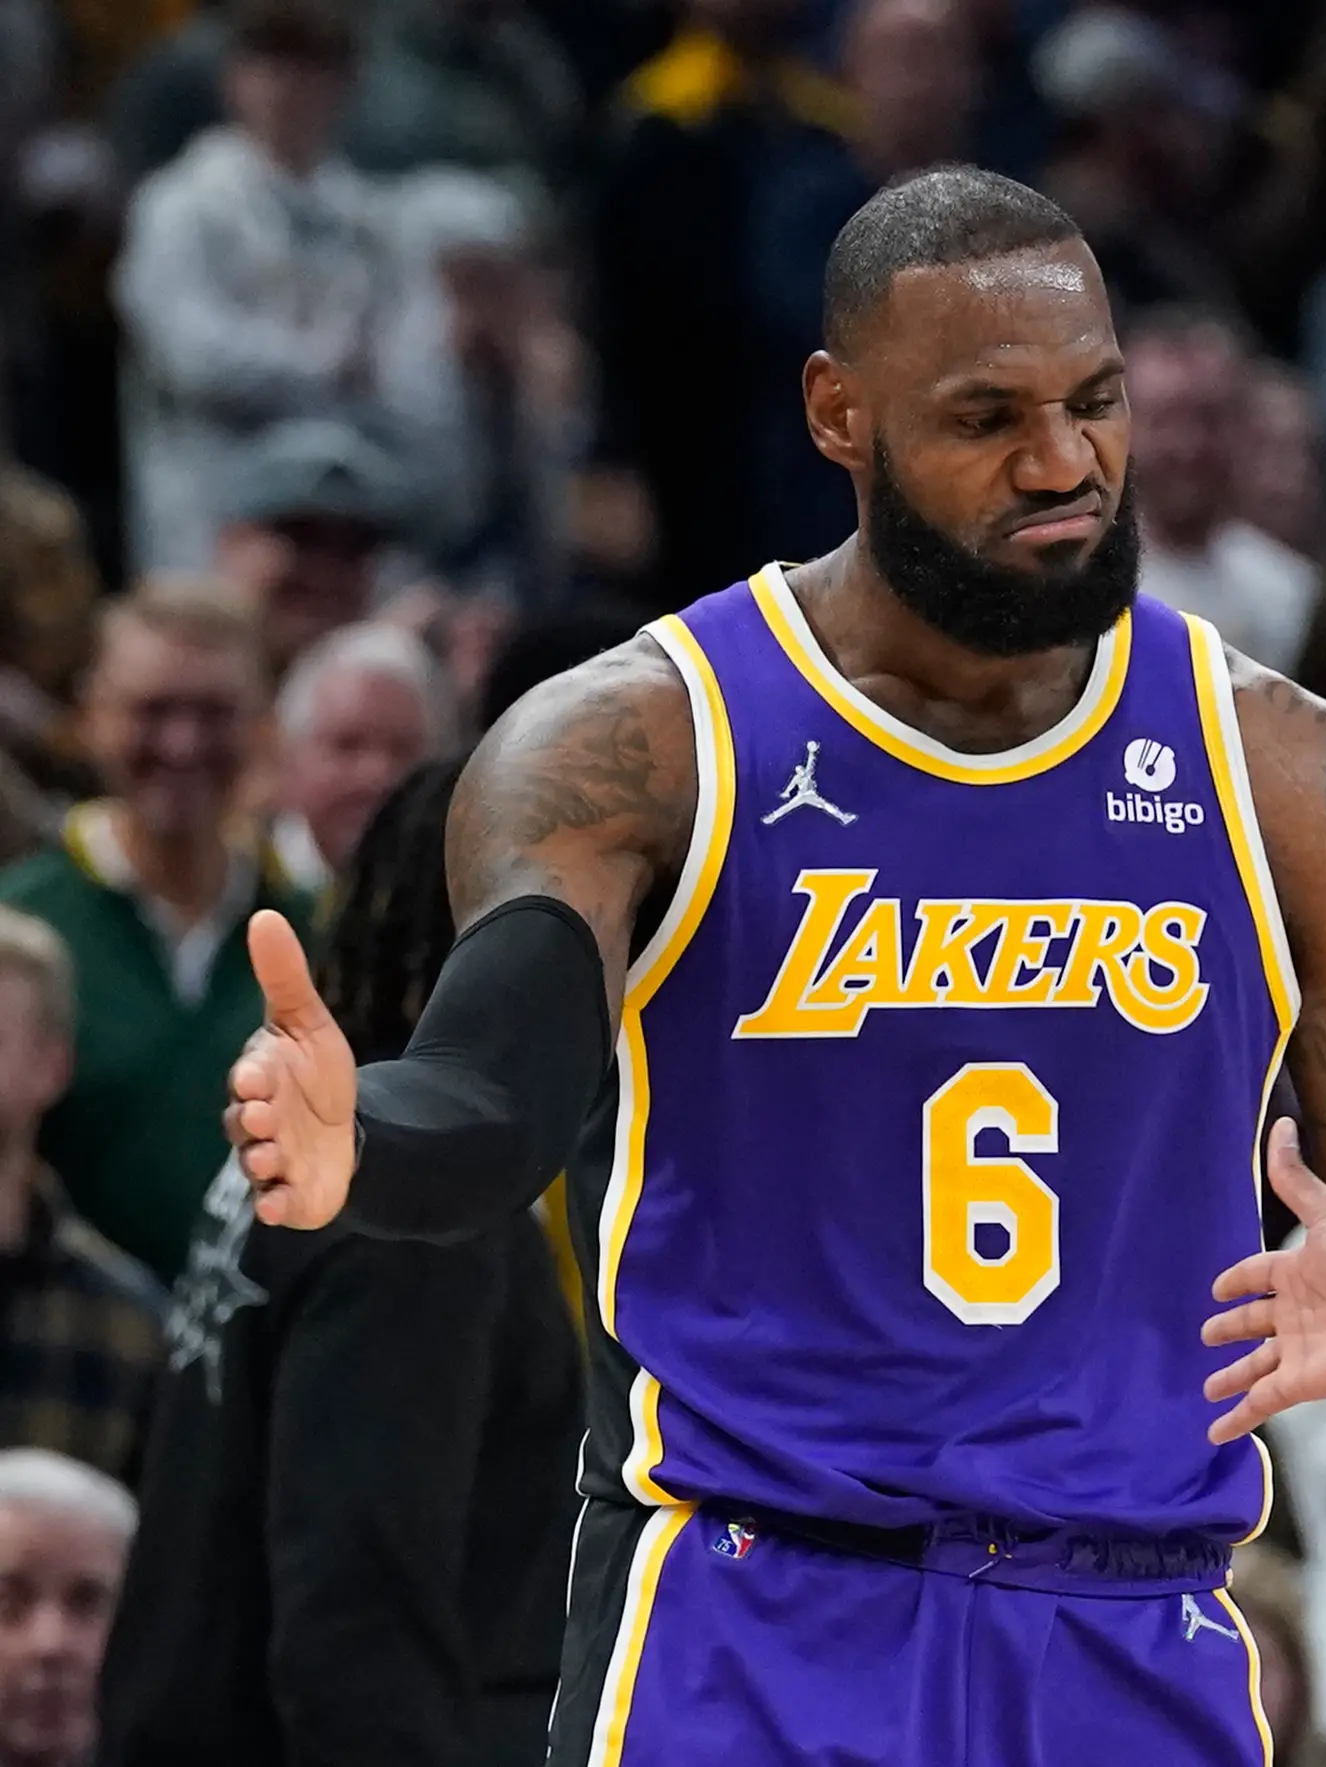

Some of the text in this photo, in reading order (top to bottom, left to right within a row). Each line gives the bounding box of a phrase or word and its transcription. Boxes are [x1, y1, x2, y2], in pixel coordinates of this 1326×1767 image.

[1106, 792, 1204, 834] bibigo
[731, 868, 1210, 1039] LAKERS
[923, 1061, 1060, 1325] 6
